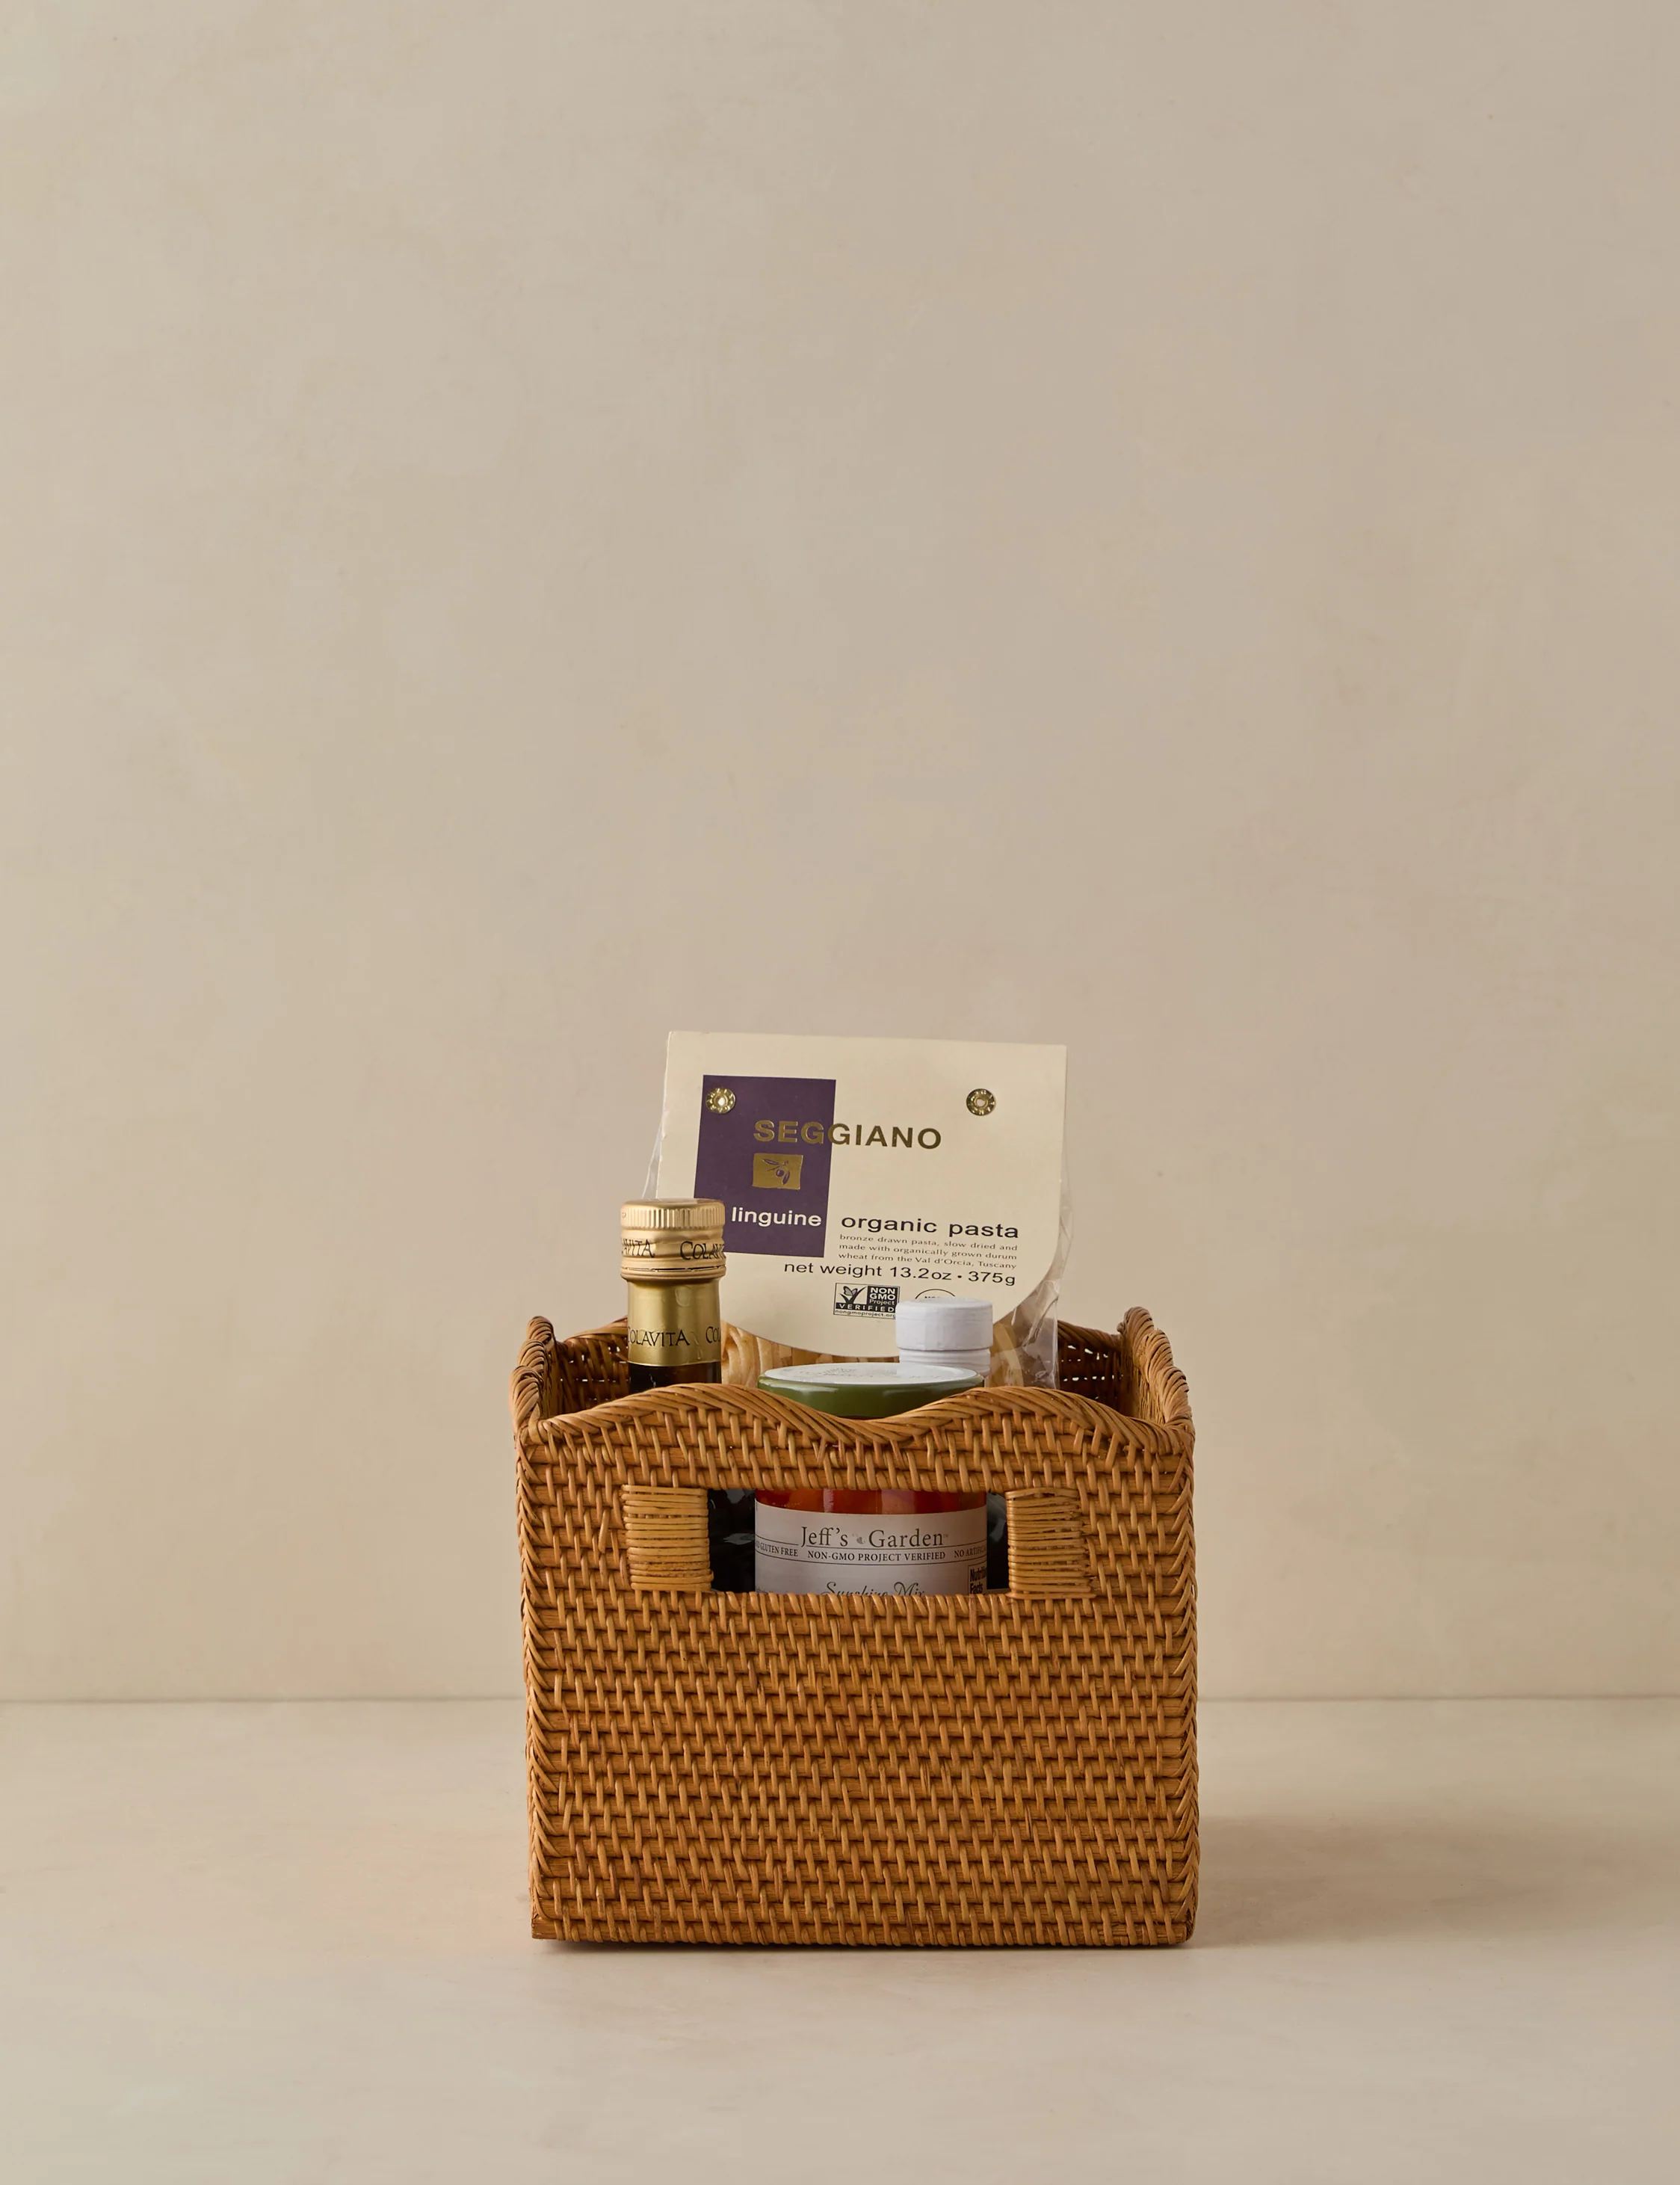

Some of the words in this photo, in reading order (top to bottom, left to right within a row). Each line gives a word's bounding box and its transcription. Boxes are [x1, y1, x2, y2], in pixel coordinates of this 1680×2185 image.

[753, 1120, 941, 1150] SEGGIANO
[732, 1206, 822, 1227] linguine
[841, 1217, 937, 1233] organic
[949, 1224, 1019, 1238] pasta
[894, 1248, 948, 1257] organically
[784, 1263, 814, 1273] net
[820, 1264, 883, 1278] weight
[889, 1266, 952, 1281] 13.2oz
[968, 1271, 1016, 1286] 375g
[978, 1261, 1016, 1270] Tuscany
[839, 1304, 895, 1313] VERIFIED
[760, 1542, 779, 1554] GLUTEN
[781, 1547, 798, 1557] FREE
[807, 1550, 855, 1561] NON-GMO
[858, 1553, 901, 1562] PROJECT
[904, 1551, 945, 1561] VERIFIED
[954, 1550, 964, 1558] NO
